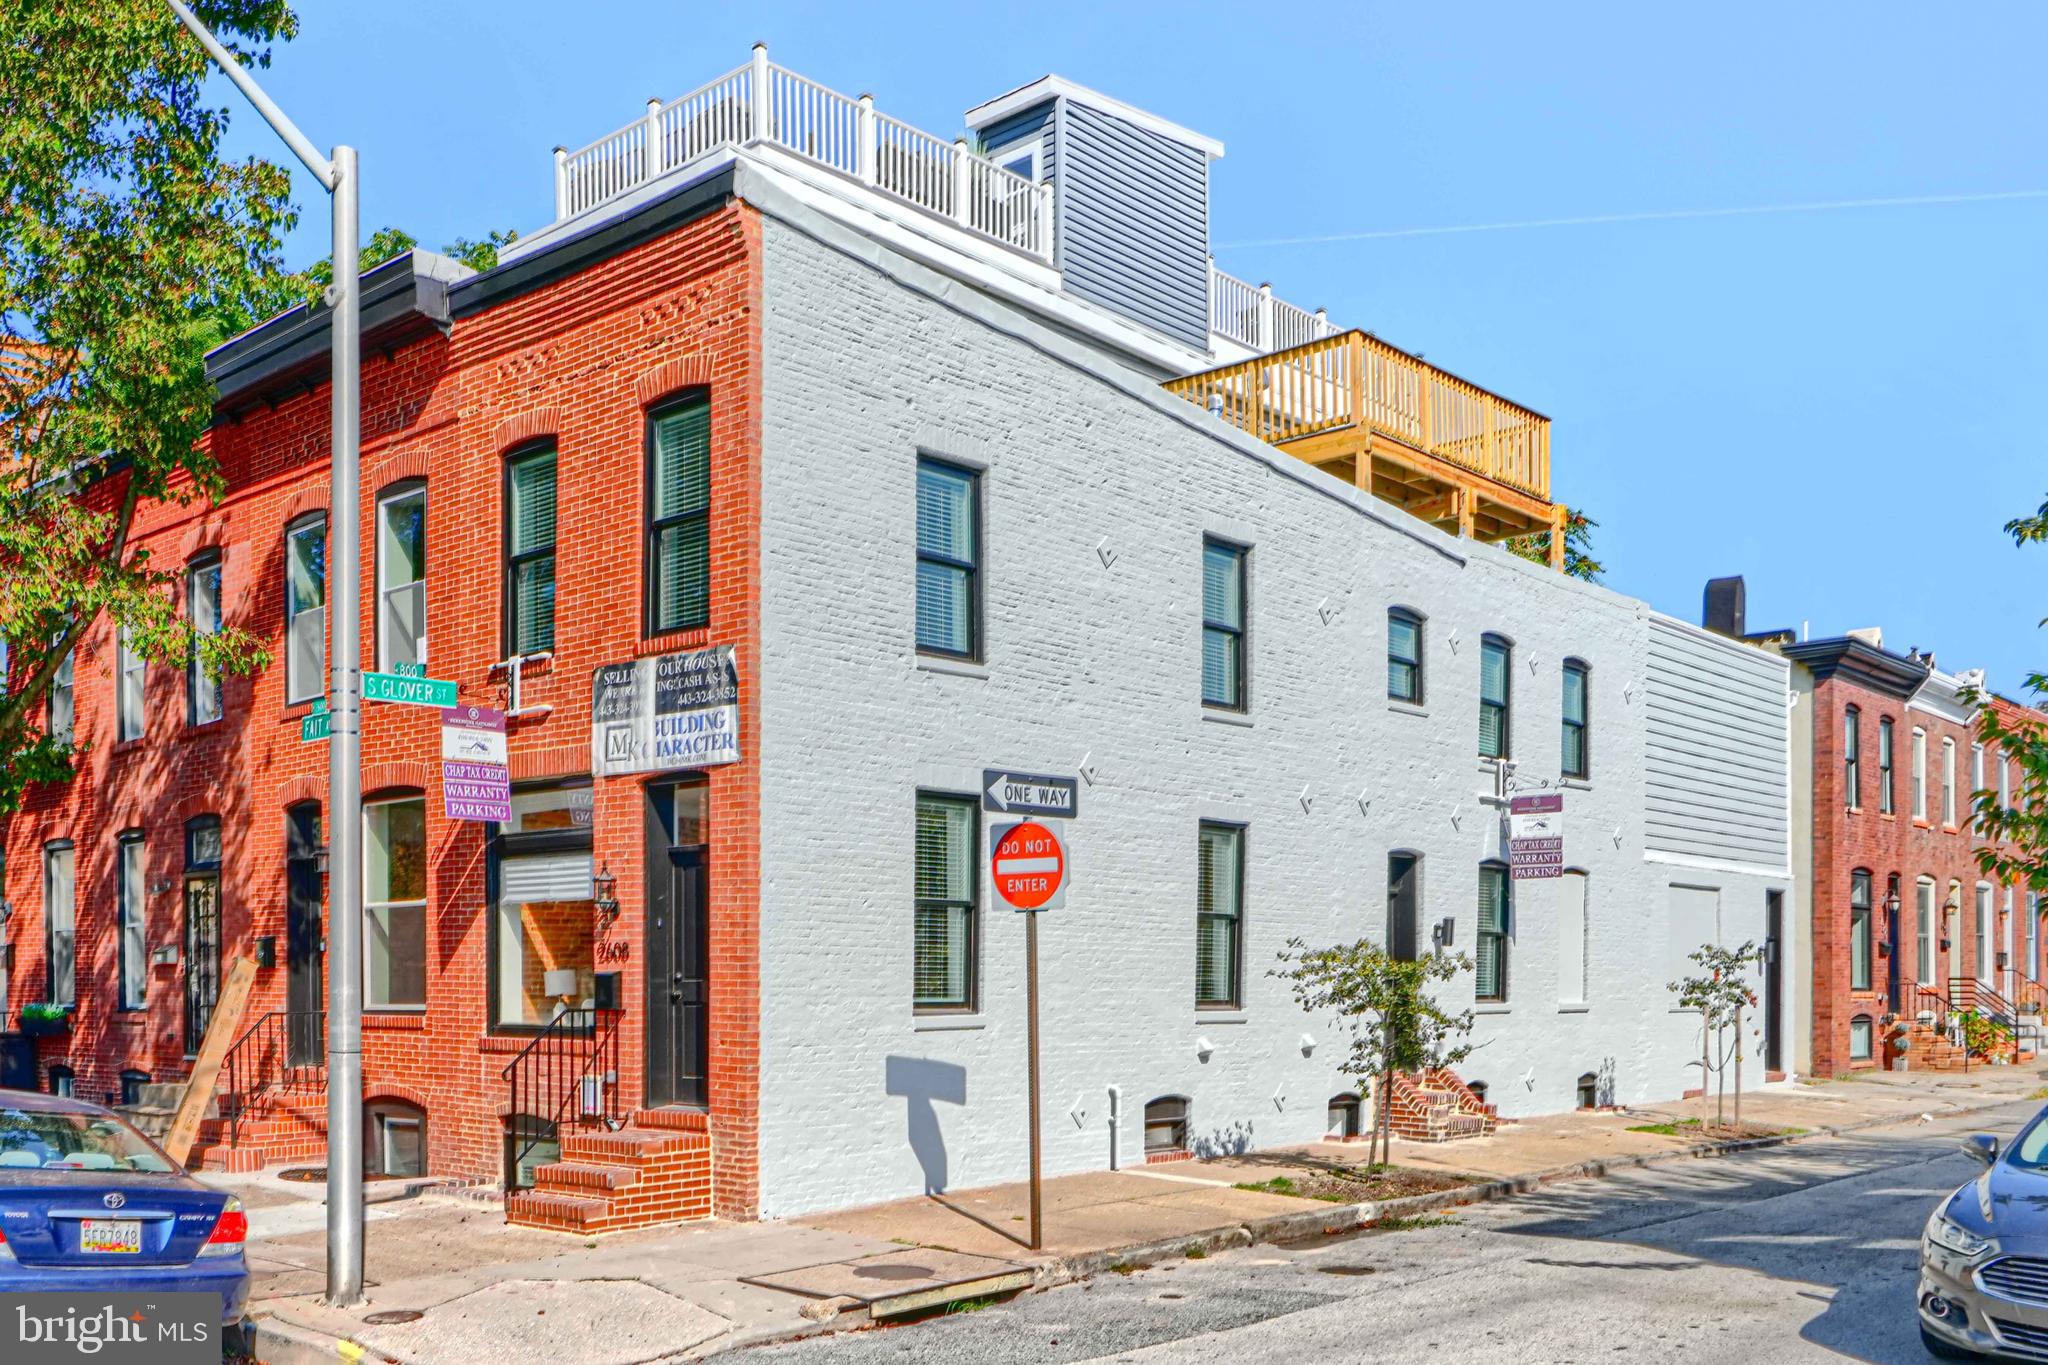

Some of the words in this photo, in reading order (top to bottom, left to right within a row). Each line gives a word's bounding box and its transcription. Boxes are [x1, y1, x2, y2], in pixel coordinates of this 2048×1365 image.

[400, 664, 418, 677] 800
[678, 674, 702, 690] CASH
[367, 679, 377, 695] S
[381, 681, 433, 702] GLOVER
[436, 688, 447, 700] ST
[304, 718, 323, 739] FAIT
[445, 764, 465, 777] CHAP
[467, 766, 479, 779] TAX
[482, 767, 506, 781] CREDIT
[446, 784, 507, 800] WARRANTY
[1004, 785, 1031, 803] ONE
[1039, 788, 1068, 806] WAY
[451, 803, 507, 818] PARKING
[1002, 841, 1019, 855] DO
[1025, 839, 1051, 854] NOT
[1512, 841, 1527, 850] CHAP
[1528, 840, 1539, 849] TAX
[1540, 839, 1561, 850] CREDIT
[1512, 853, 1562, 864] WARRANTY
[1515, 867, 1559, 878] PARKING
[1007, 878, 1048, 893] ENTER
[597, 941, 630, 964] 2608
